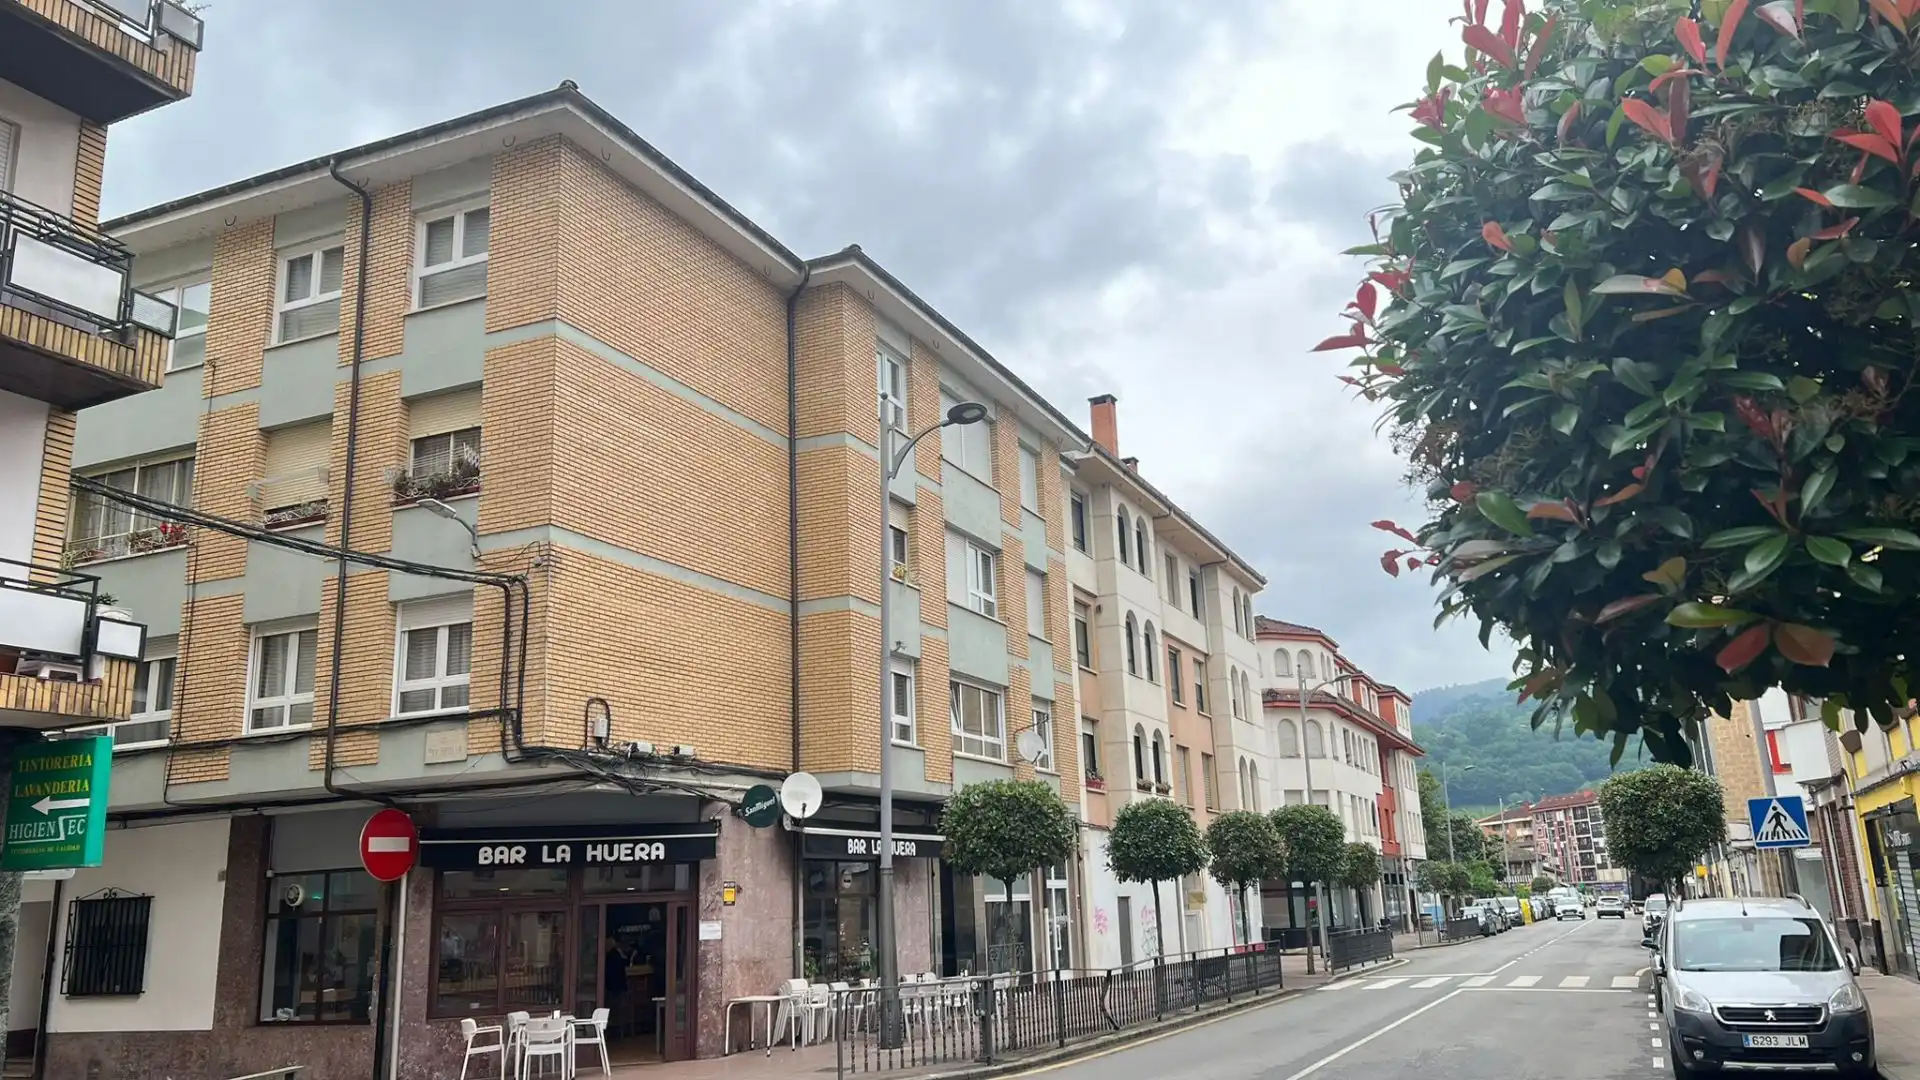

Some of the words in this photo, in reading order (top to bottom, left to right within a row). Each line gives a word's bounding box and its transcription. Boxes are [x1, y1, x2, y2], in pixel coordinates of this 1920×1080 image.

[478, 845, 527, 865] BAR
[541, 844, 571, 863] LA
[586, 842, 665, 862] HUERA
[847, 838, 867, 855] BAR
[871, 839, 882, 855] LA
[891, 840, 916, 857] UERA
[1752, 1035, 1779, 1046] 6293
[1785, 1036, 1807, 1047] JLM
